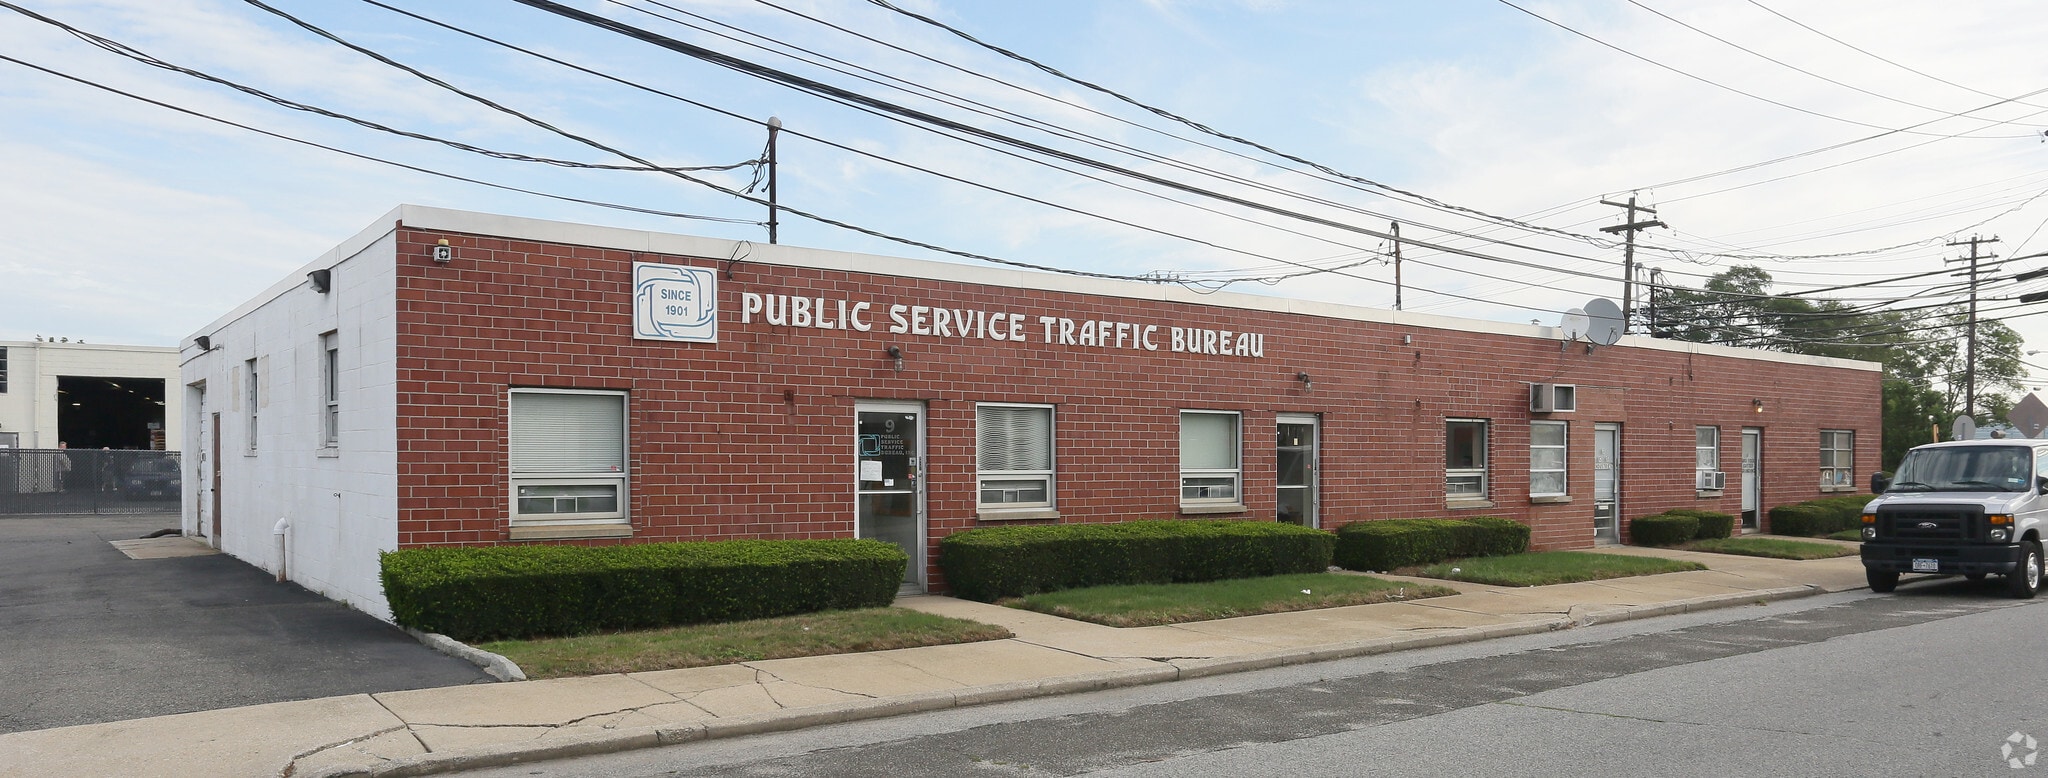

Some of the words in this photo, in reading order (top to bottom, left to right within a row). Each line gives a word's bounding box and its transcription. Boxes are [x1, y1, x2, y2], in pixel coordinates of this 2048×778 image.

[660, 288, 692, 301] SINCE
[665, 304, 688, 317] 1901
[741, 292, 872, 332] PUBLIC
[889, 304, 1026, 342] SERVICE
[1039, 316, 1158, 351] TRAFFIC
[1171, 327, 1264, 358] BUREAU
[885, 419, 895, 433] 9
